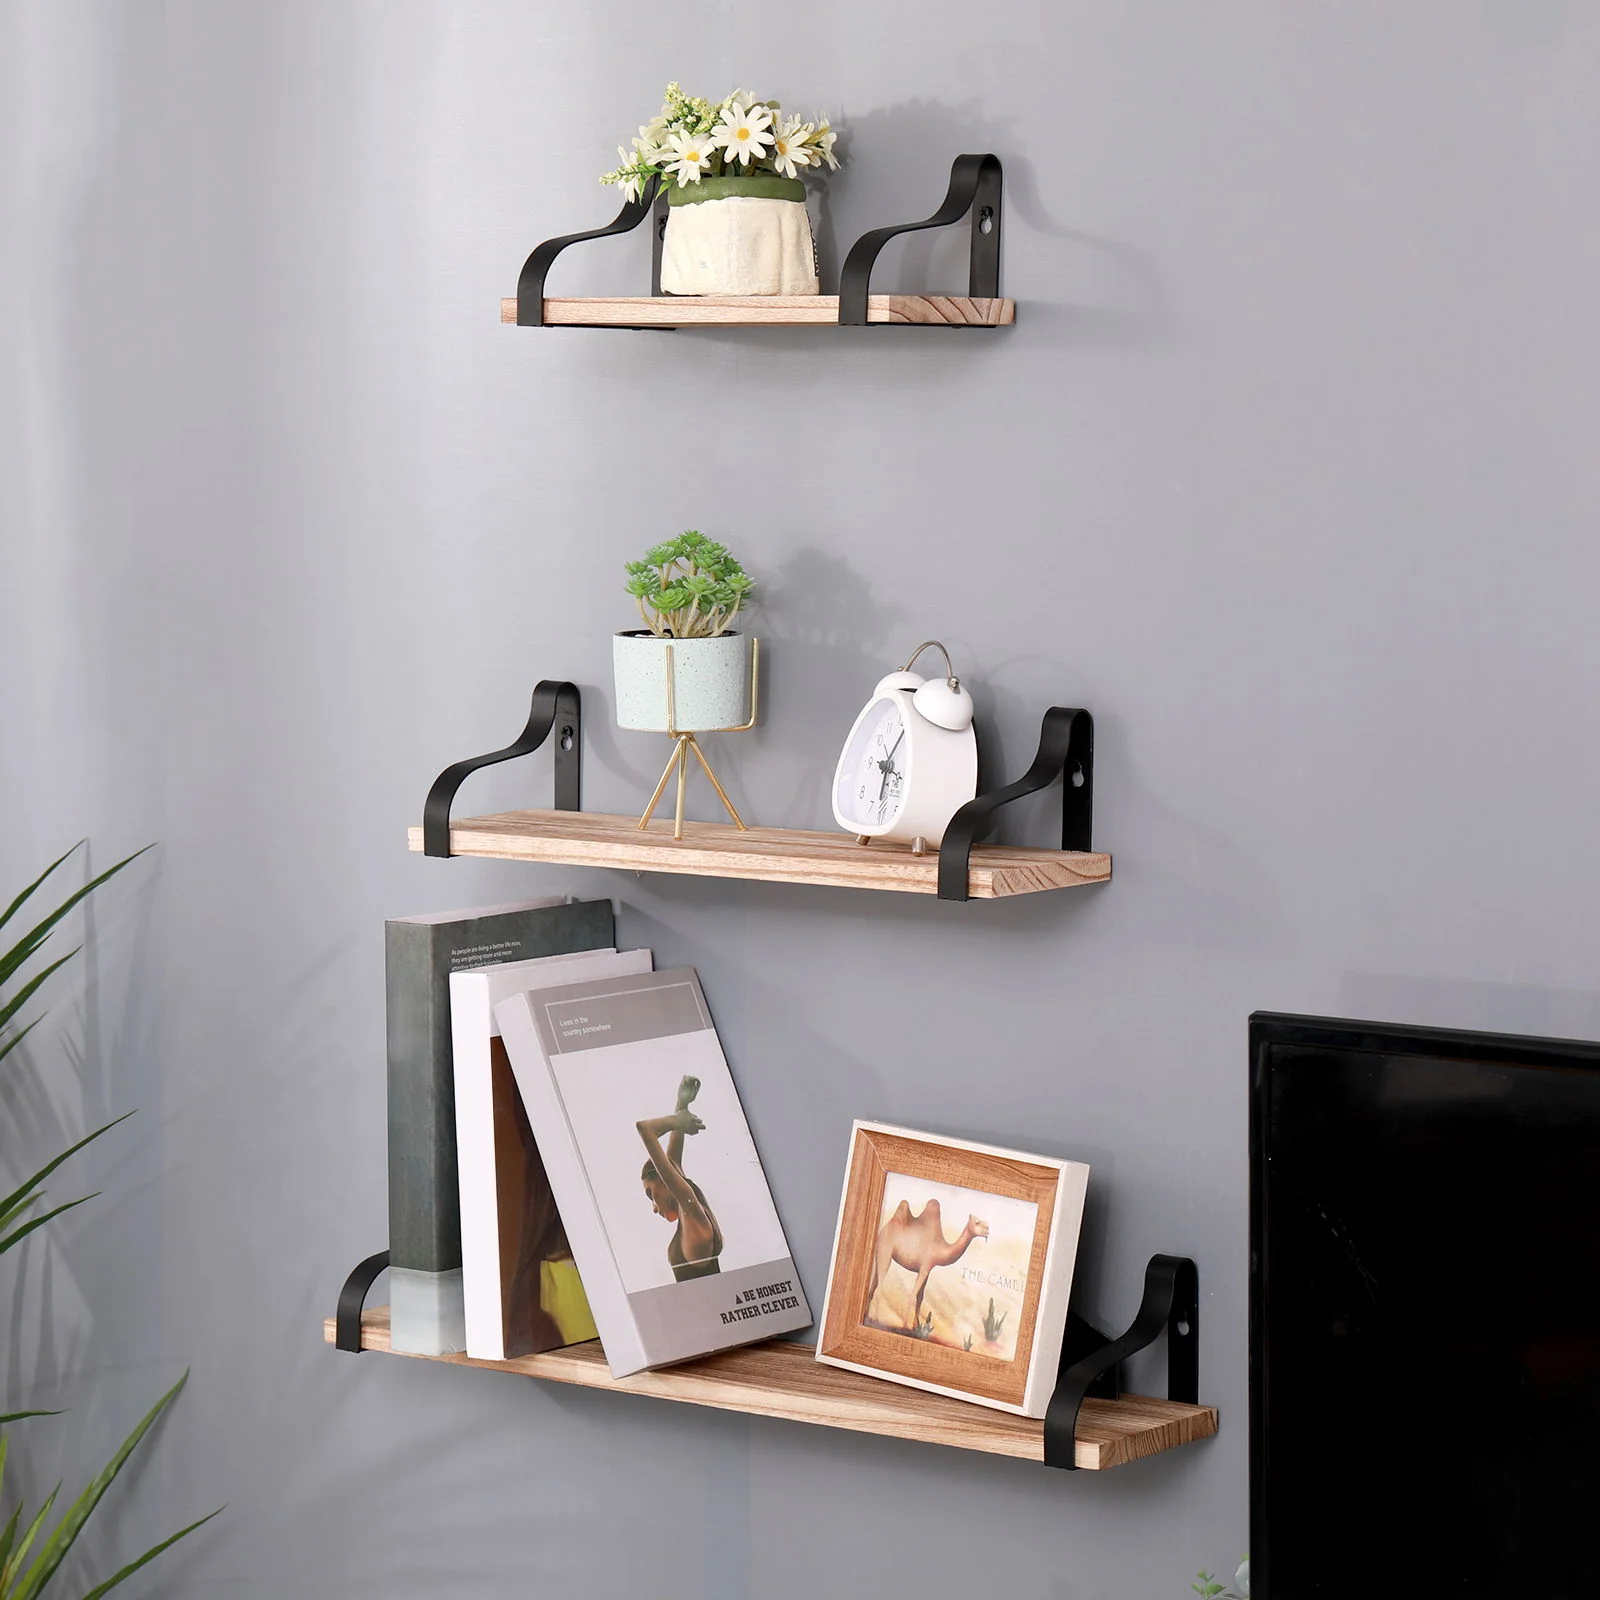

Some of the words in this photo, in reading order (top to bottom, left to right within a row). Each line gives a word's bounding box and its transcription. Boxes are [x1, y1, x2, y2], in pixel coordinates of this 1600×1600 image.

[457, 947, 471, 956] people
[468, 954, 483, 962] getting
[560, 1019, 574, 1027] Lives
[563, 1028, 582, 1037] country
[582, 1023, 611, 1034] somewhere
[961, 1267, 983, 1283] THE
[743, 1289, 756, 1302] BE
[756, 1281, 793, 1299] HONEST
[720, 1305, 761, 1325] RATHER
[761, 1296, 800, 1315] CLEVER
